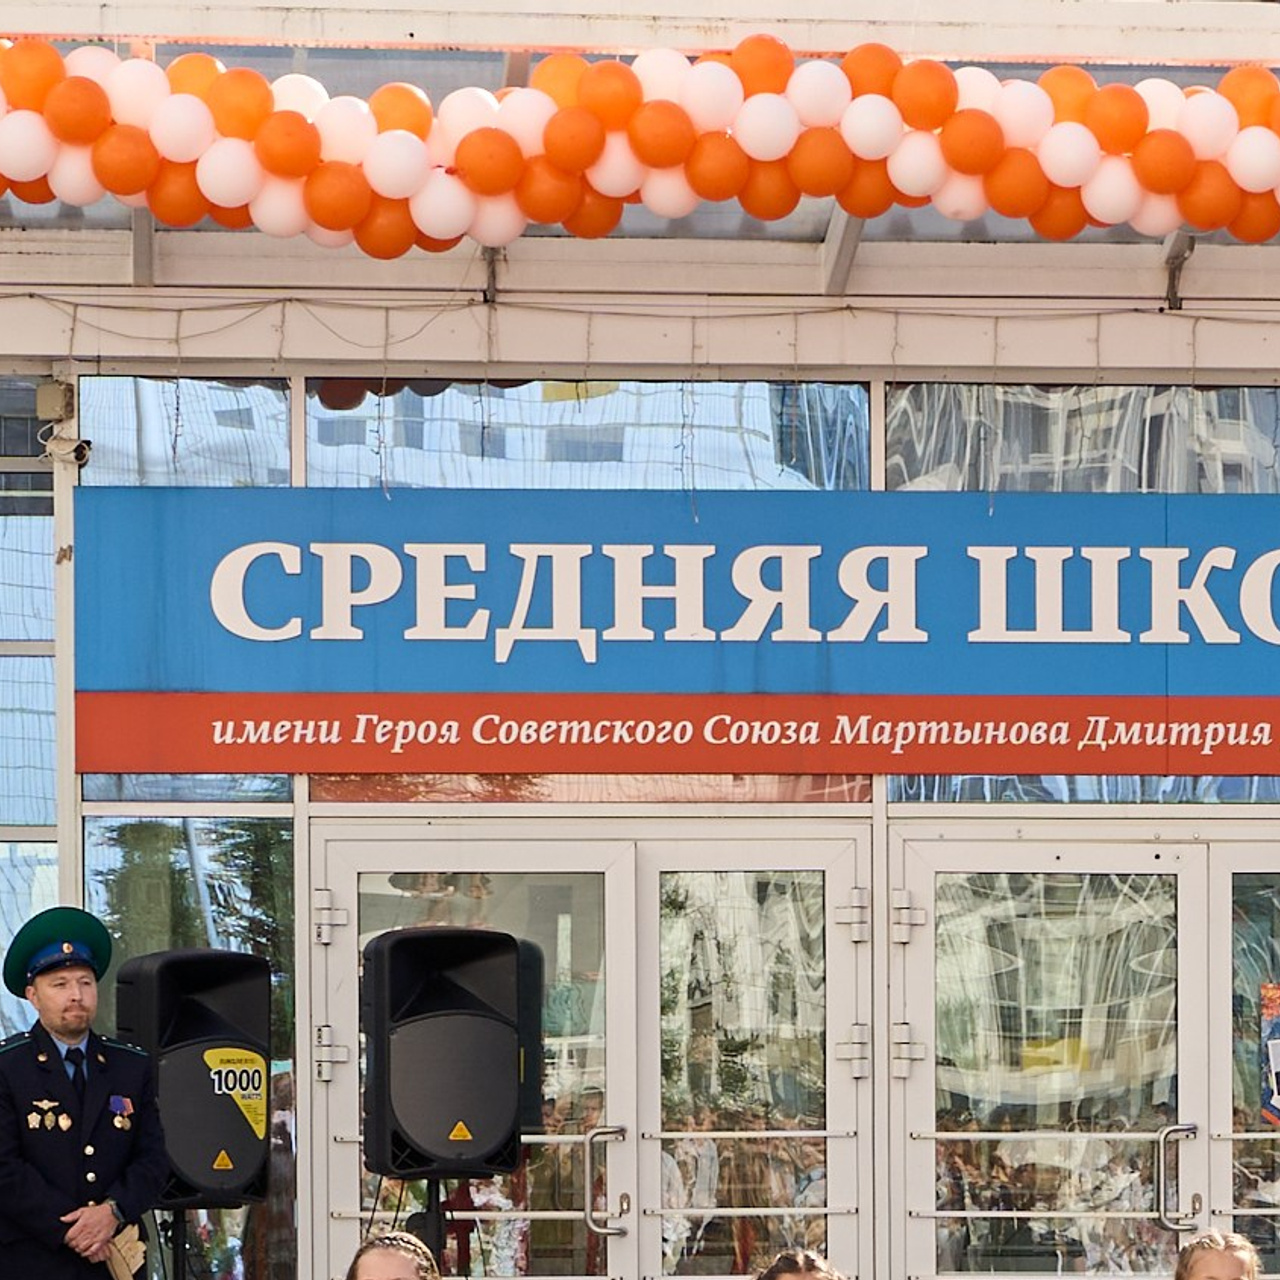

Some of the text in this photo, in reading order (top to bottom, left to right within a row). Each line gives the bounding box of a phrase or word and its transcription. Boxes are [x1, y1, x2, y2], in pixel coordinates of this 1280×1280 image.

[210, 541, 929, 663] СРЕДНЯЯ
[211, 720, 342, 745] имени
[352, 714, 461, 754] Героя
[472, 714, 694, 745] Советского
[703, 714, 821, 745] Союза
[830, 715, 1070, 755] Мартынова
[1078, 716, 1273, 754] Дмитрия
[212, 1068, 263, 1092] 1000
